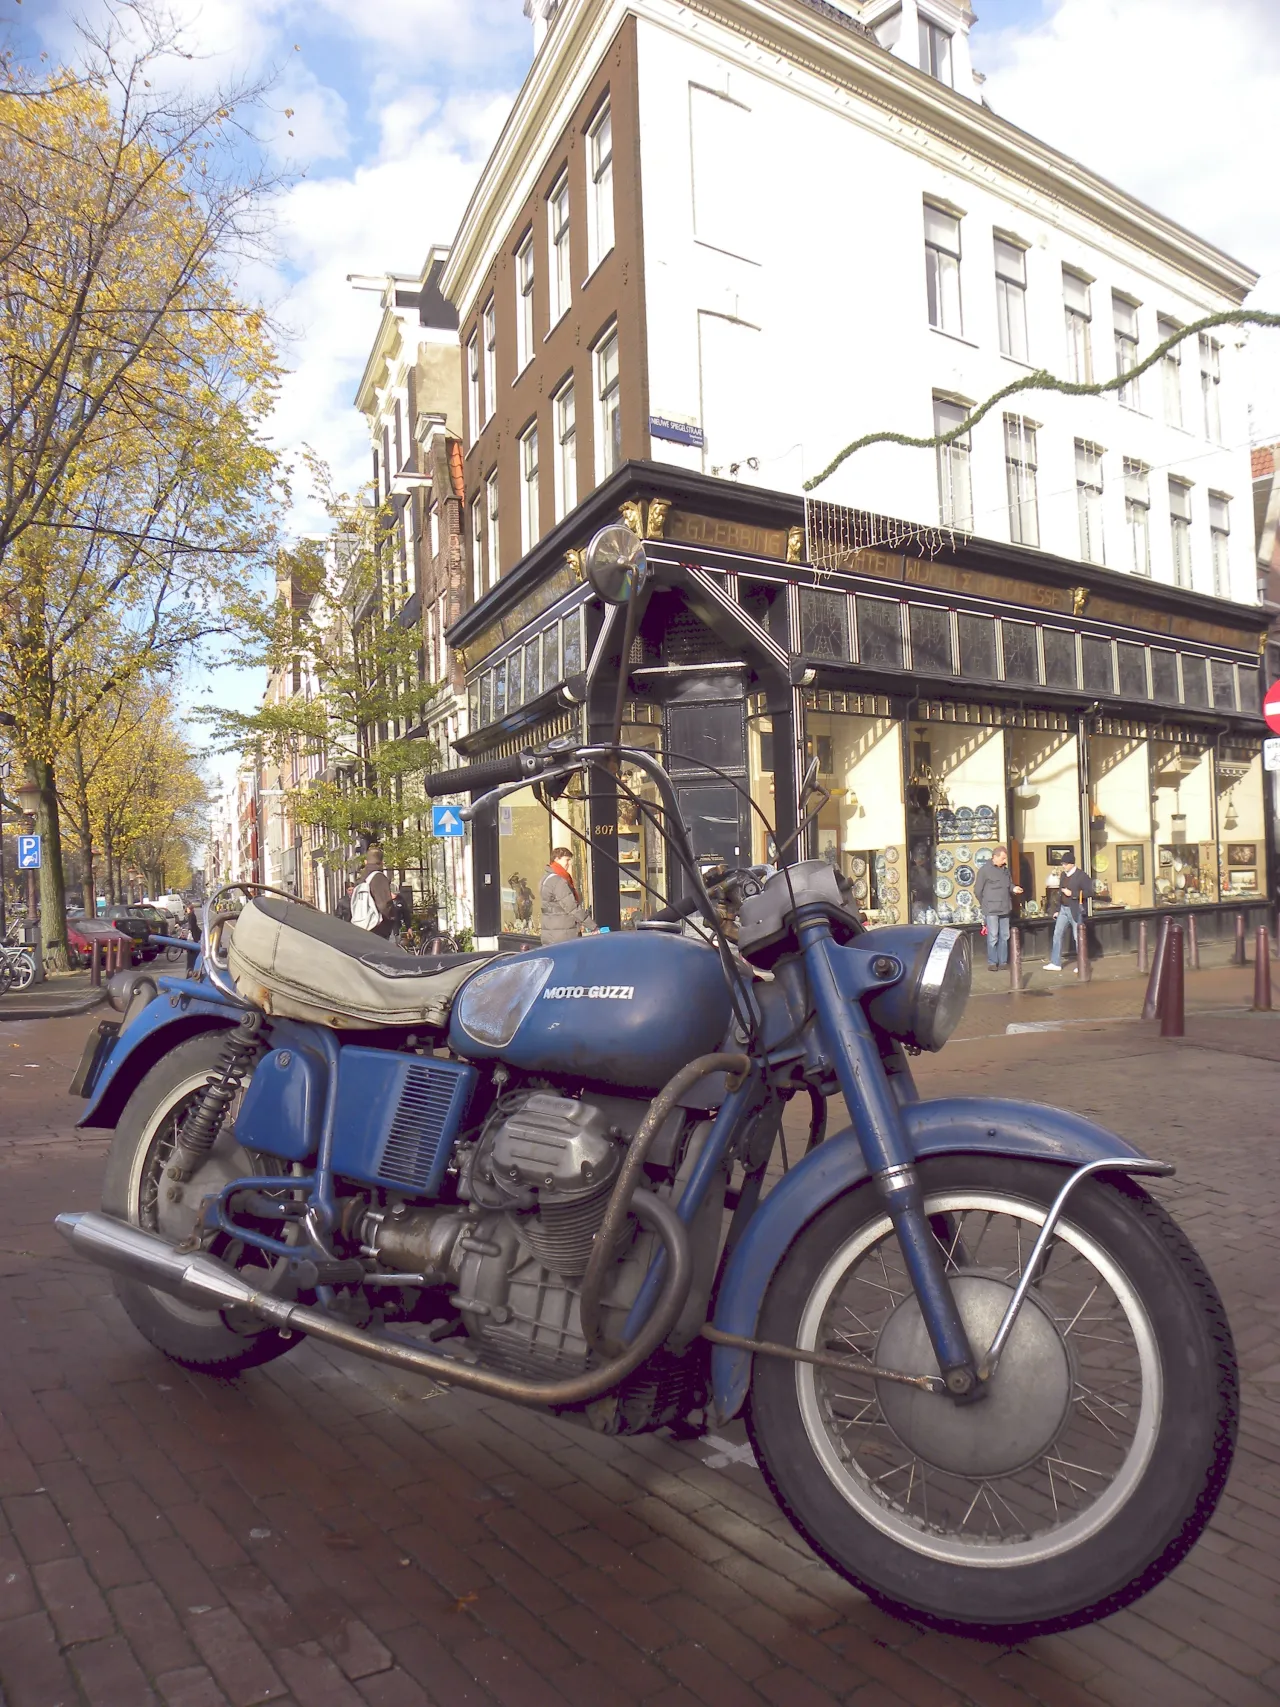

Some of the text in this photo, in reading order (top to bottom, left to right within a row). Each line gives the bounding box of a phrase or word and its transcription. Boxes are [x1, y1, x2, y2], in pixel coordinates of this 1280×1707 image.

[651, 417, 703, 436] NIEUWE SPIEGELSTRAAT
[595, 825, 614, 835] 807
[23, 838, 36, 855] P
[543, 985, 635, 1000] MOTO GUZZI
